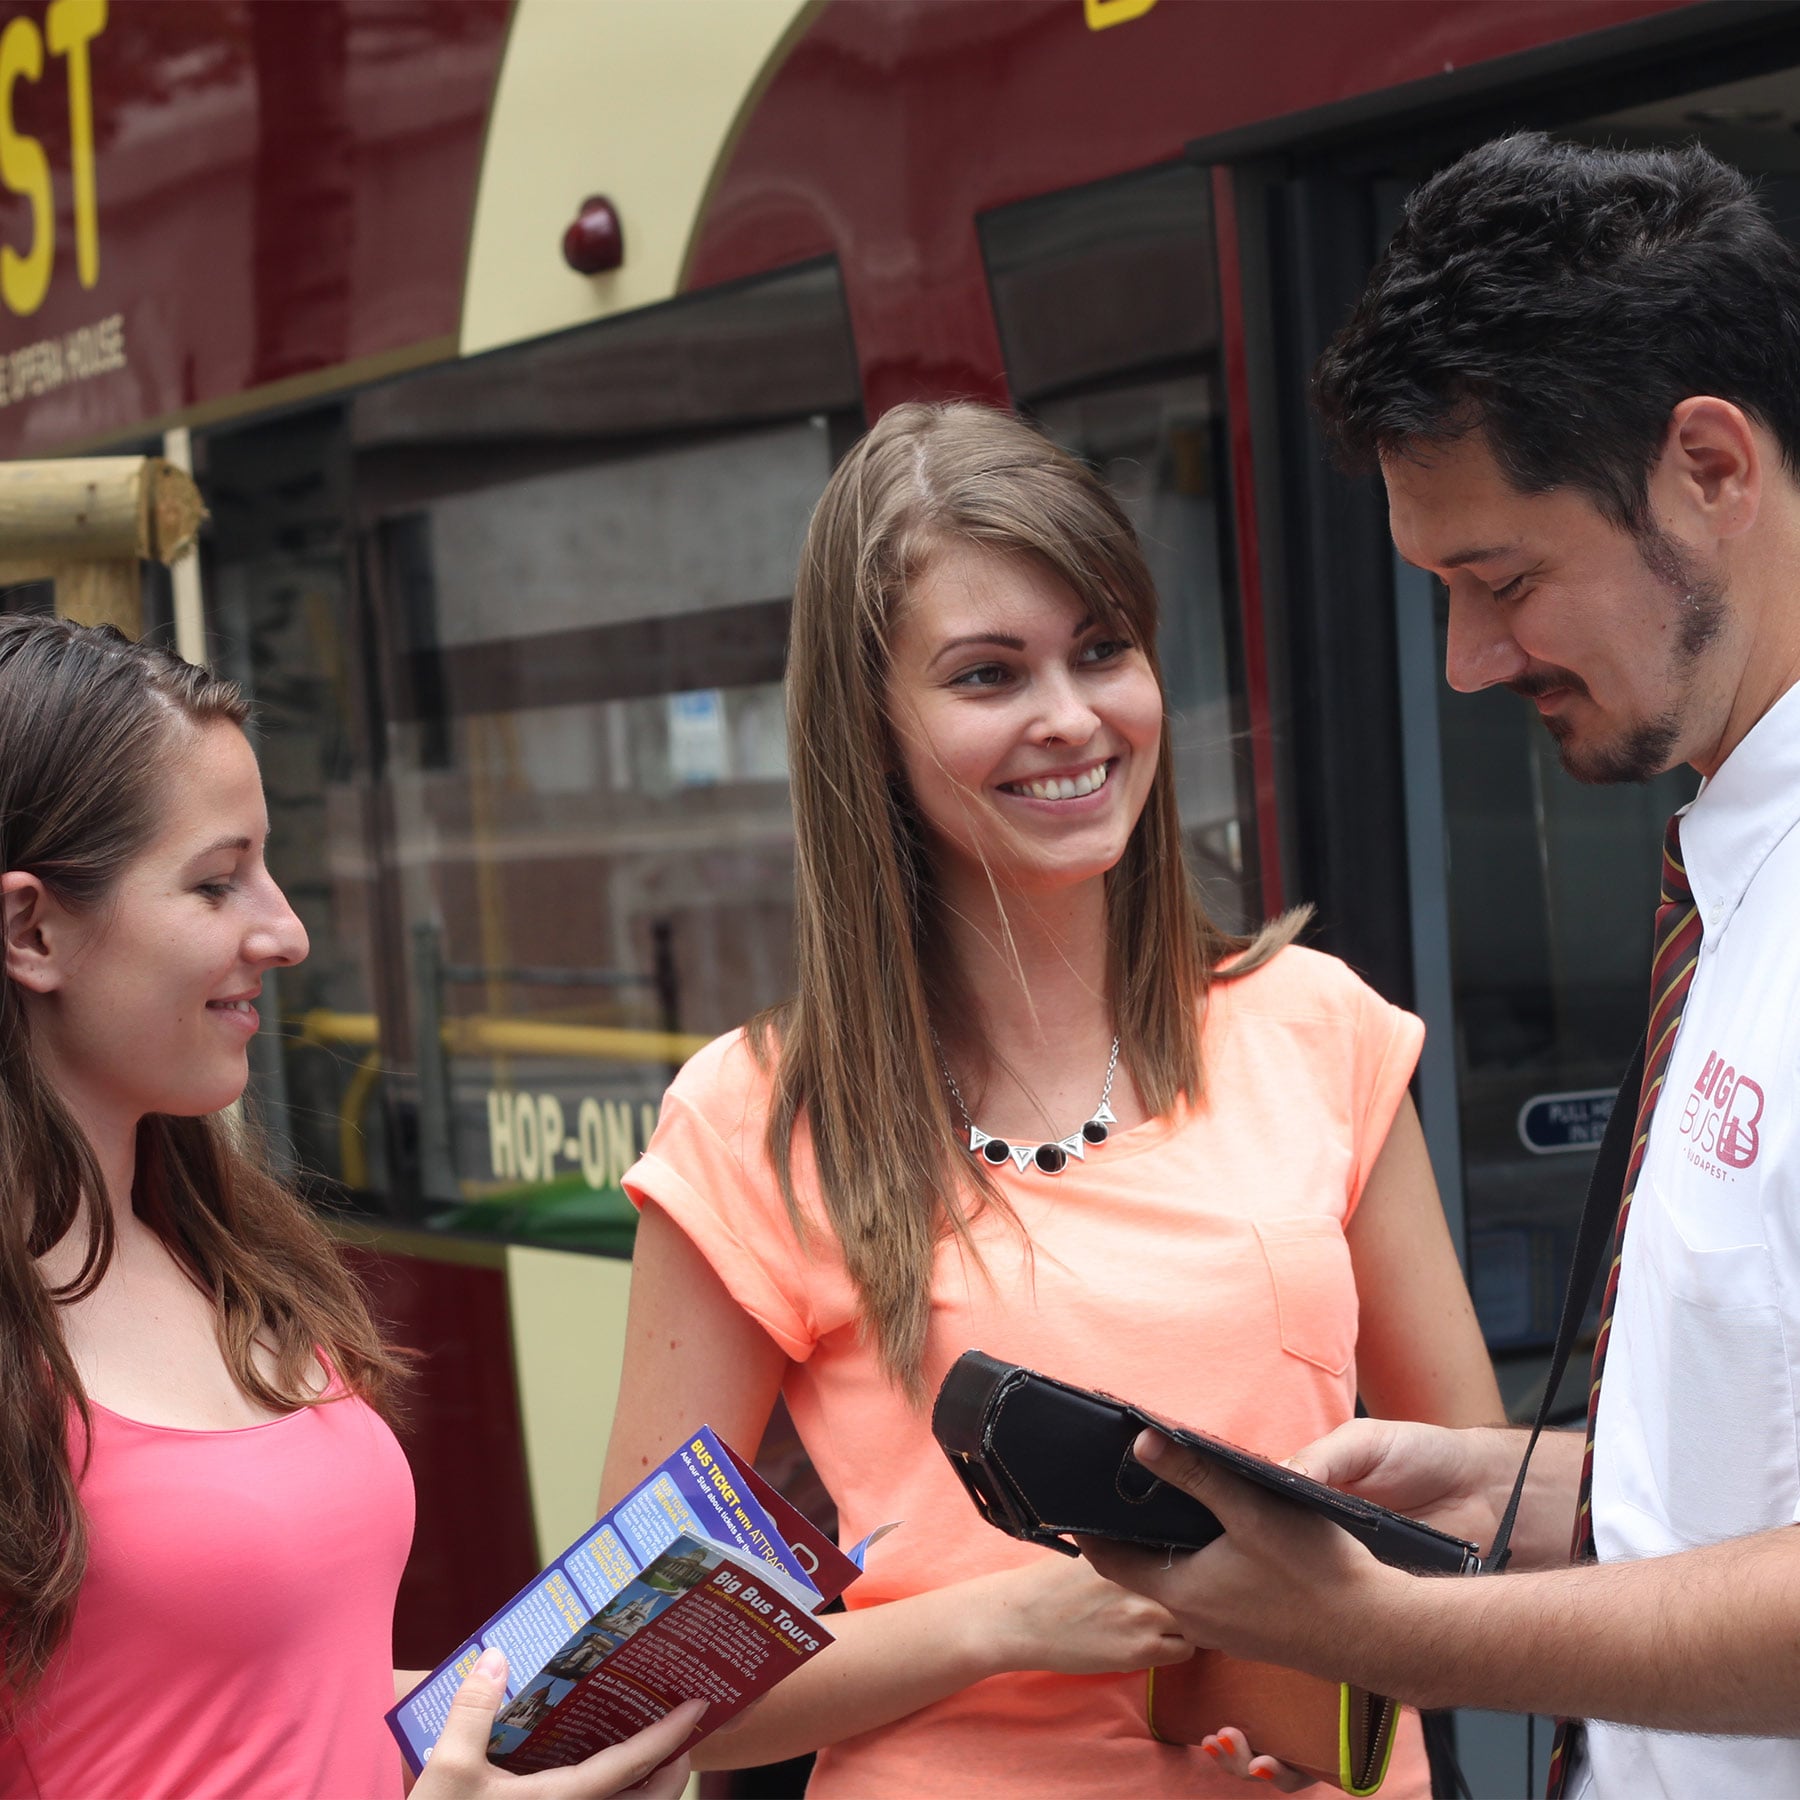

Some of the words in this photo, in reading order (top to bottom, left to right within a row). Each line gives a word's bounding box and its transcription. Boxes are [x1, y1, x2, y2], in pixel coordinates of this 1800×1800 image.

[0, 0, 109, 316] ST
[488, 1090, 636, 1191] HOP-ON
[1680, 1093, 1719, 1152] BUS
[650, 1483, 682, 1525] THERMAL
[657, 1477, 675, 1497] BUS
[669, 1495, 689, 1519] TOUR
[679, 1450, 693, 1466] Ask
[687, 1463, 700, 1478] our
[695, 1475, 711, 1494] Staff
[706, 1491, 724, 1513] about
[719, 1510, 739, 1535] tickets
[733, 1532, 746, 1545] for
[688, 1438, 714, 1468] BUS
[705, 1462, 741, 1509] TICKET
[732, 1506, 753, 1531] WITH
[585, 1541, 623, 1591] FUNICULAR
[600, 1529, 618, 1549] BUS
[612, 1547, 633, 1571] TOUR
[543, 1581, 567, 1611] OPERA
[550, 1574, 568, 1594] BUS
[562, 1592, 583, 1616] TOUR
[711, 1566, 744, 1598] Big
[738, 1582, 777, 1617] Bus
[770, 1607, 823, 1654] Tours
[713, 1586, 736, 1606] perfect
[733, 1599, 771, 1630] introduction
[773, 1630, 804, 1657] Budapest
[714, 1614, 730, 1628] tour
[733, 1628, 764, 1654] Budapest
[716, 1625, 731, 1639] best
[728, 1634, 748, 1651] views
[684, 1652, 700, 1665] with
[695, 1632, 709, 1645] trip
[705, 1639, 732, 1662] through
[628, 1686, 649, 1703] strives
[645, 1666, 671, 1686] discover
[663, 1668, 679, 1682] This
[675, 1677, 696, 1694] really
[664, 1659, 685, 1675] cruise
[692, 1679, 712, 1697] enjoy
[676, 1657, 696, 1674] along
[702, 1676, 730, 1699] Danube
